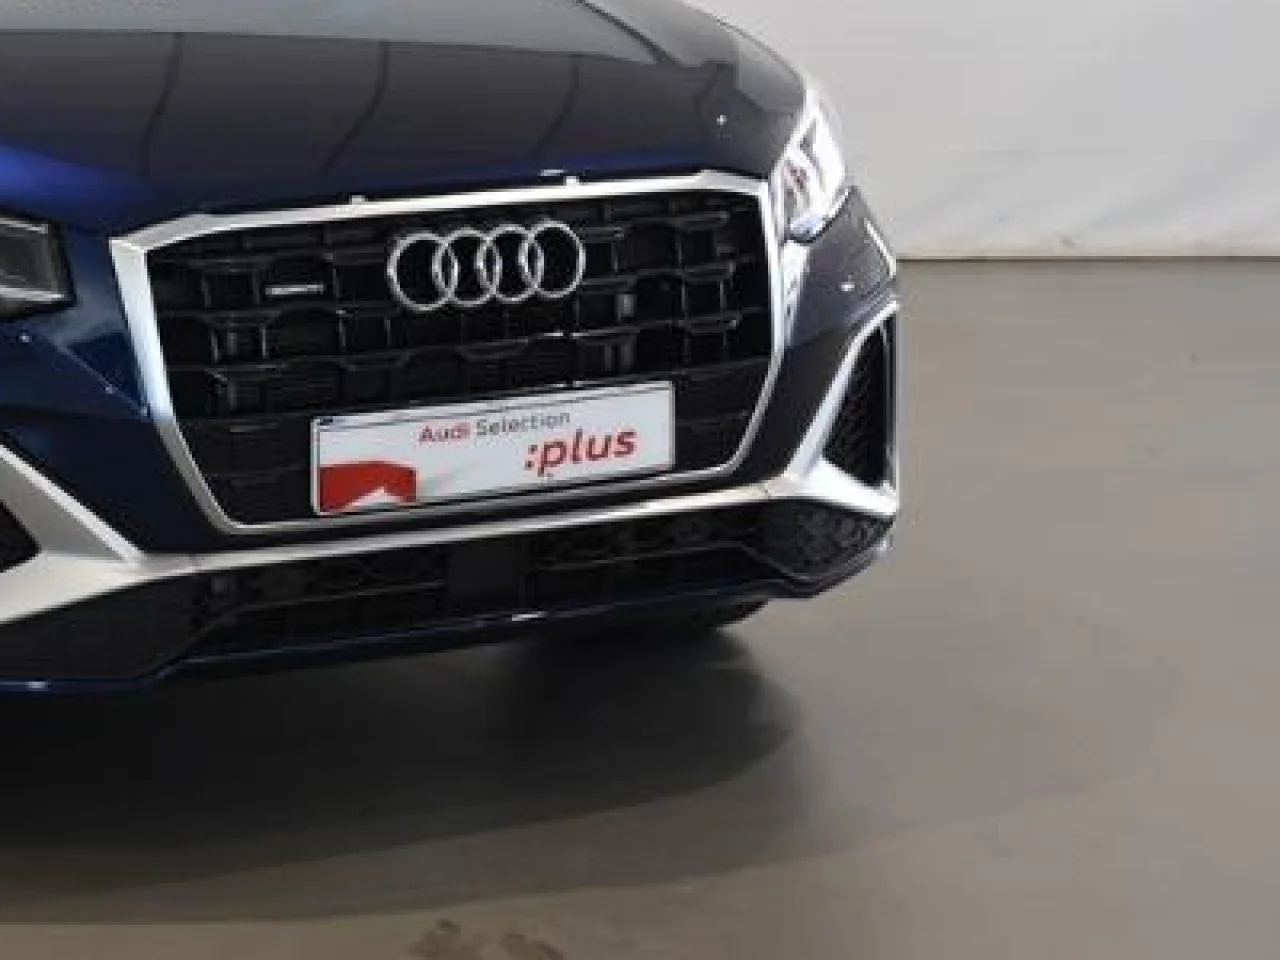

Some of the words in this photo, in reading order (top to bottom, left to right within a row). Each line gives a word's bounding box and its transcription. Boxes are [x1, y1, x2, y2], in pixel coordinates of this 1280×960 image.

[419, 425, 471, 442] Audi
[476, 411, 571, 436] Selection
[524, 428, 637, 477] :plus
